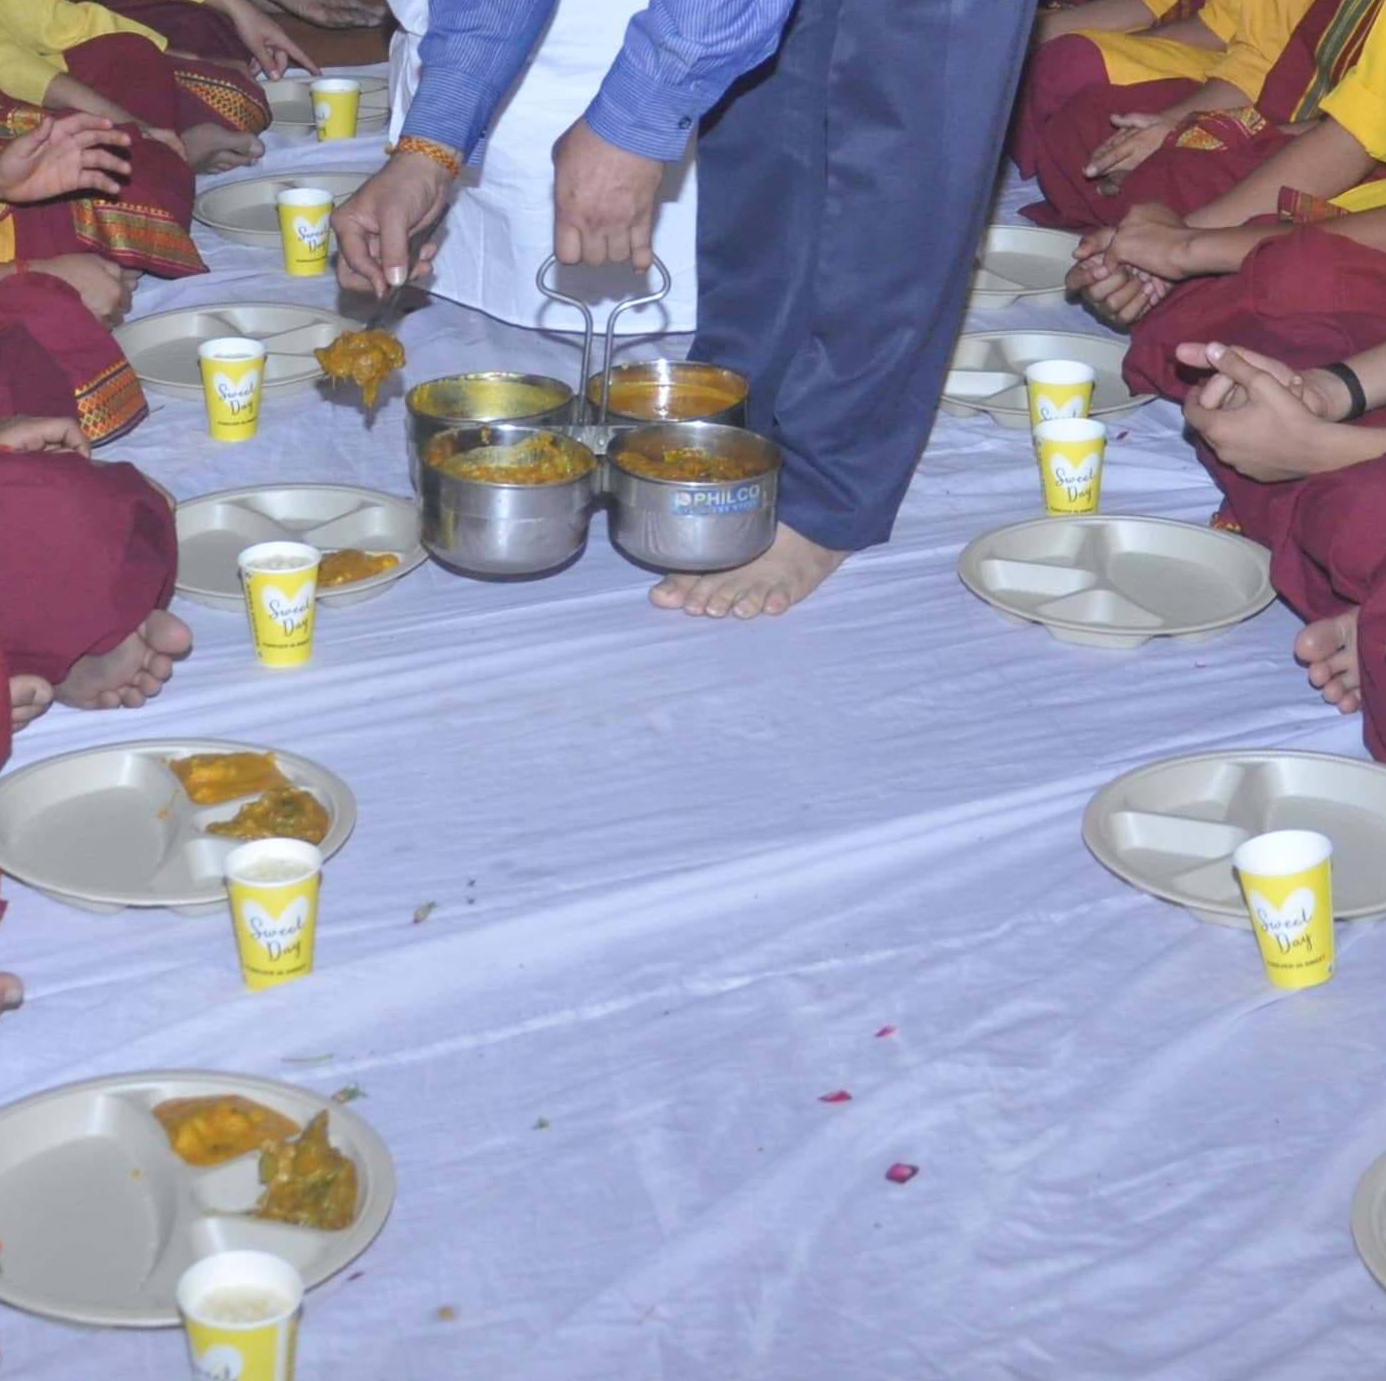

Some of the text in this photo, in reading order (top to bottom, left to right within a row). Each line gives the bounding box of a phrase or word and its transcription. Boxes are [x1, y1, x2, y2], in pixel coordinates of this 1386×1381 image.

[218, 381, 256, 401] Sweet
[229, 399, 254, 417] Day
[1055, 466, 1095, 487] Sweet
[693, 483, 762, 506] PHILCO
[1067, 486, 1093, 503] Day
[268, 595, 311, 620] Sweet
[283, 617, 310, 637] Day
[250, 915, 306, 940] Sweet
[1257, 906, 1313, 932] Sweet
[266, 939, 302, 963] Day
[1274, 931, 1313, 956] Day
